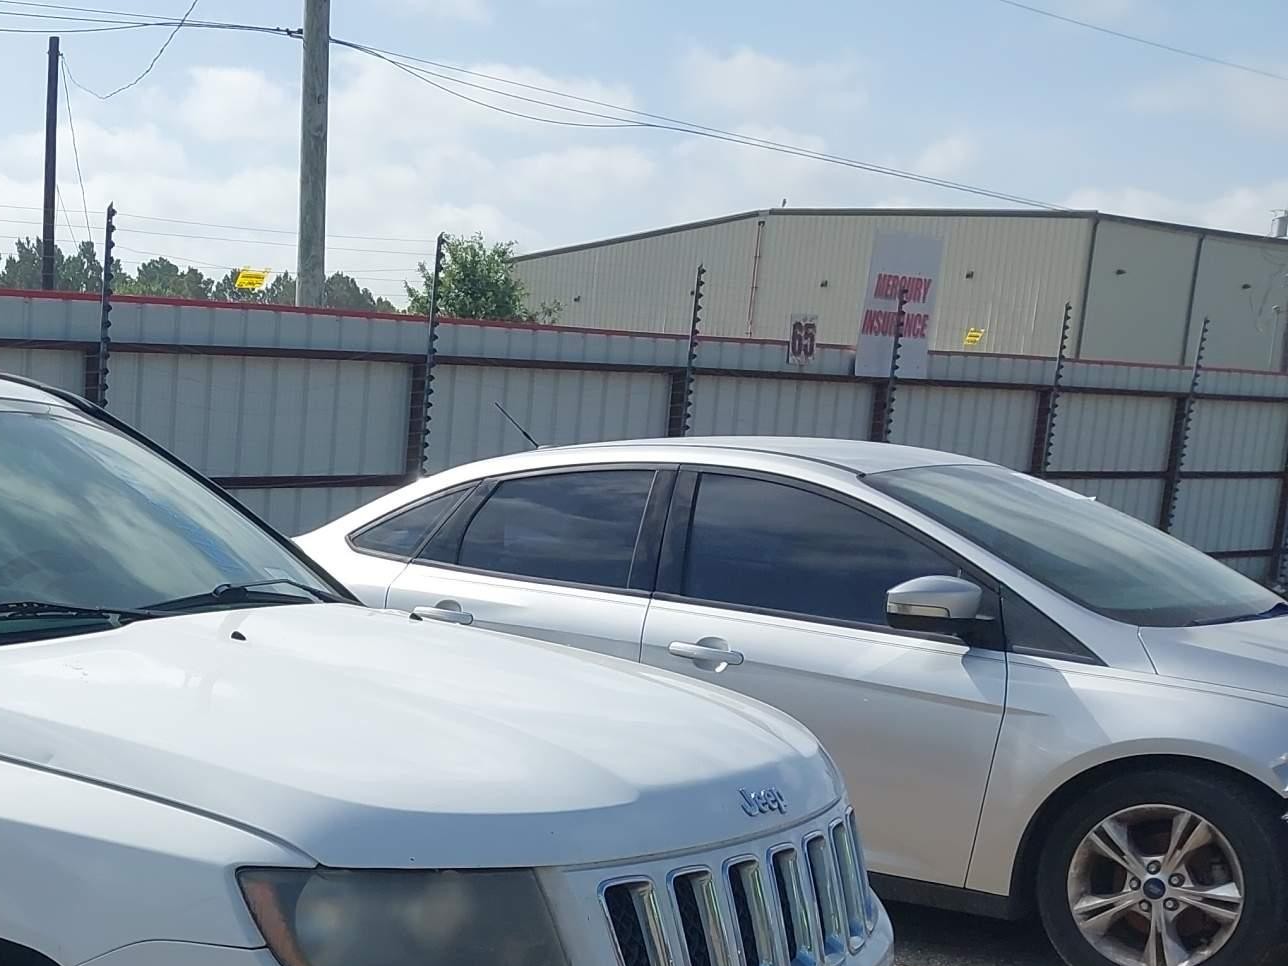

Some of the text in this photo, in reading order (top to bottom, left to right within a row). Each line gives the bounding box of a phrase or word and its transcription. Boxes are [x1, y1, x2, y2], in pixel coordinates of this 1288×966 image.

[874, 274, 932, 303] MERCURY
[862, 310, 929, 338] INSURNCE
[791, 321, 817, 358] 65
[738, 788, 788, 817] Jeep
